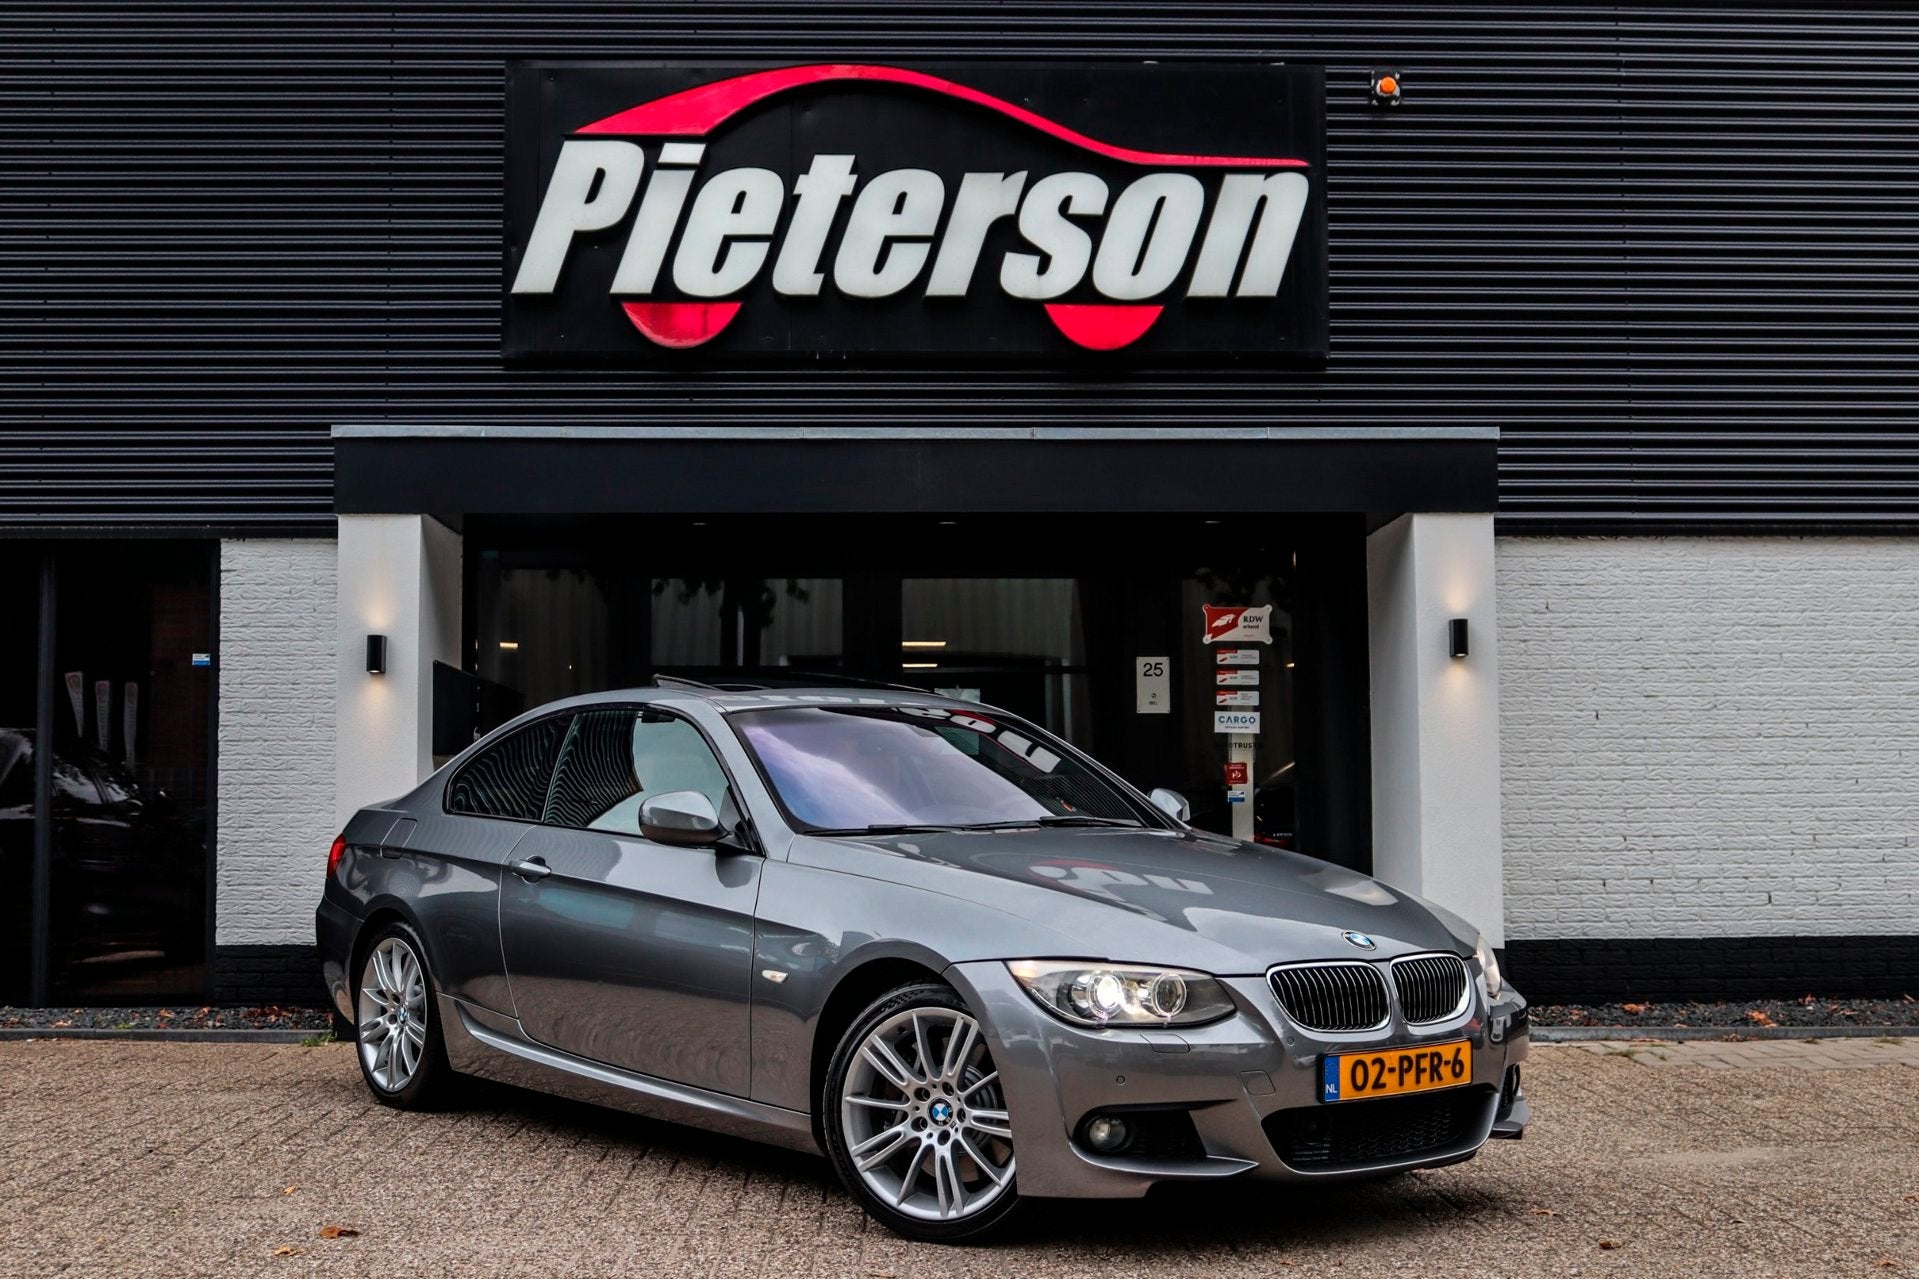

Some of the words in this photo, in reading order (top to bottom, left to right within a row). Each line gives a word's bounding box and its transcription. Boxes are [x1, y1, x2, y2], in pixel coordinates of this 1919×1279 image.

[511, 139, 1310, 301] Pieterson
[1243, 615, 1263, 623] RDW
[1143, 662, 1163, 677] 25
[1218, 716, 1256, 724] CARGO
[1350, 1047, 1464, 1092] 02-PFR-6
[1325, 1084, 1338, 1094] NL
